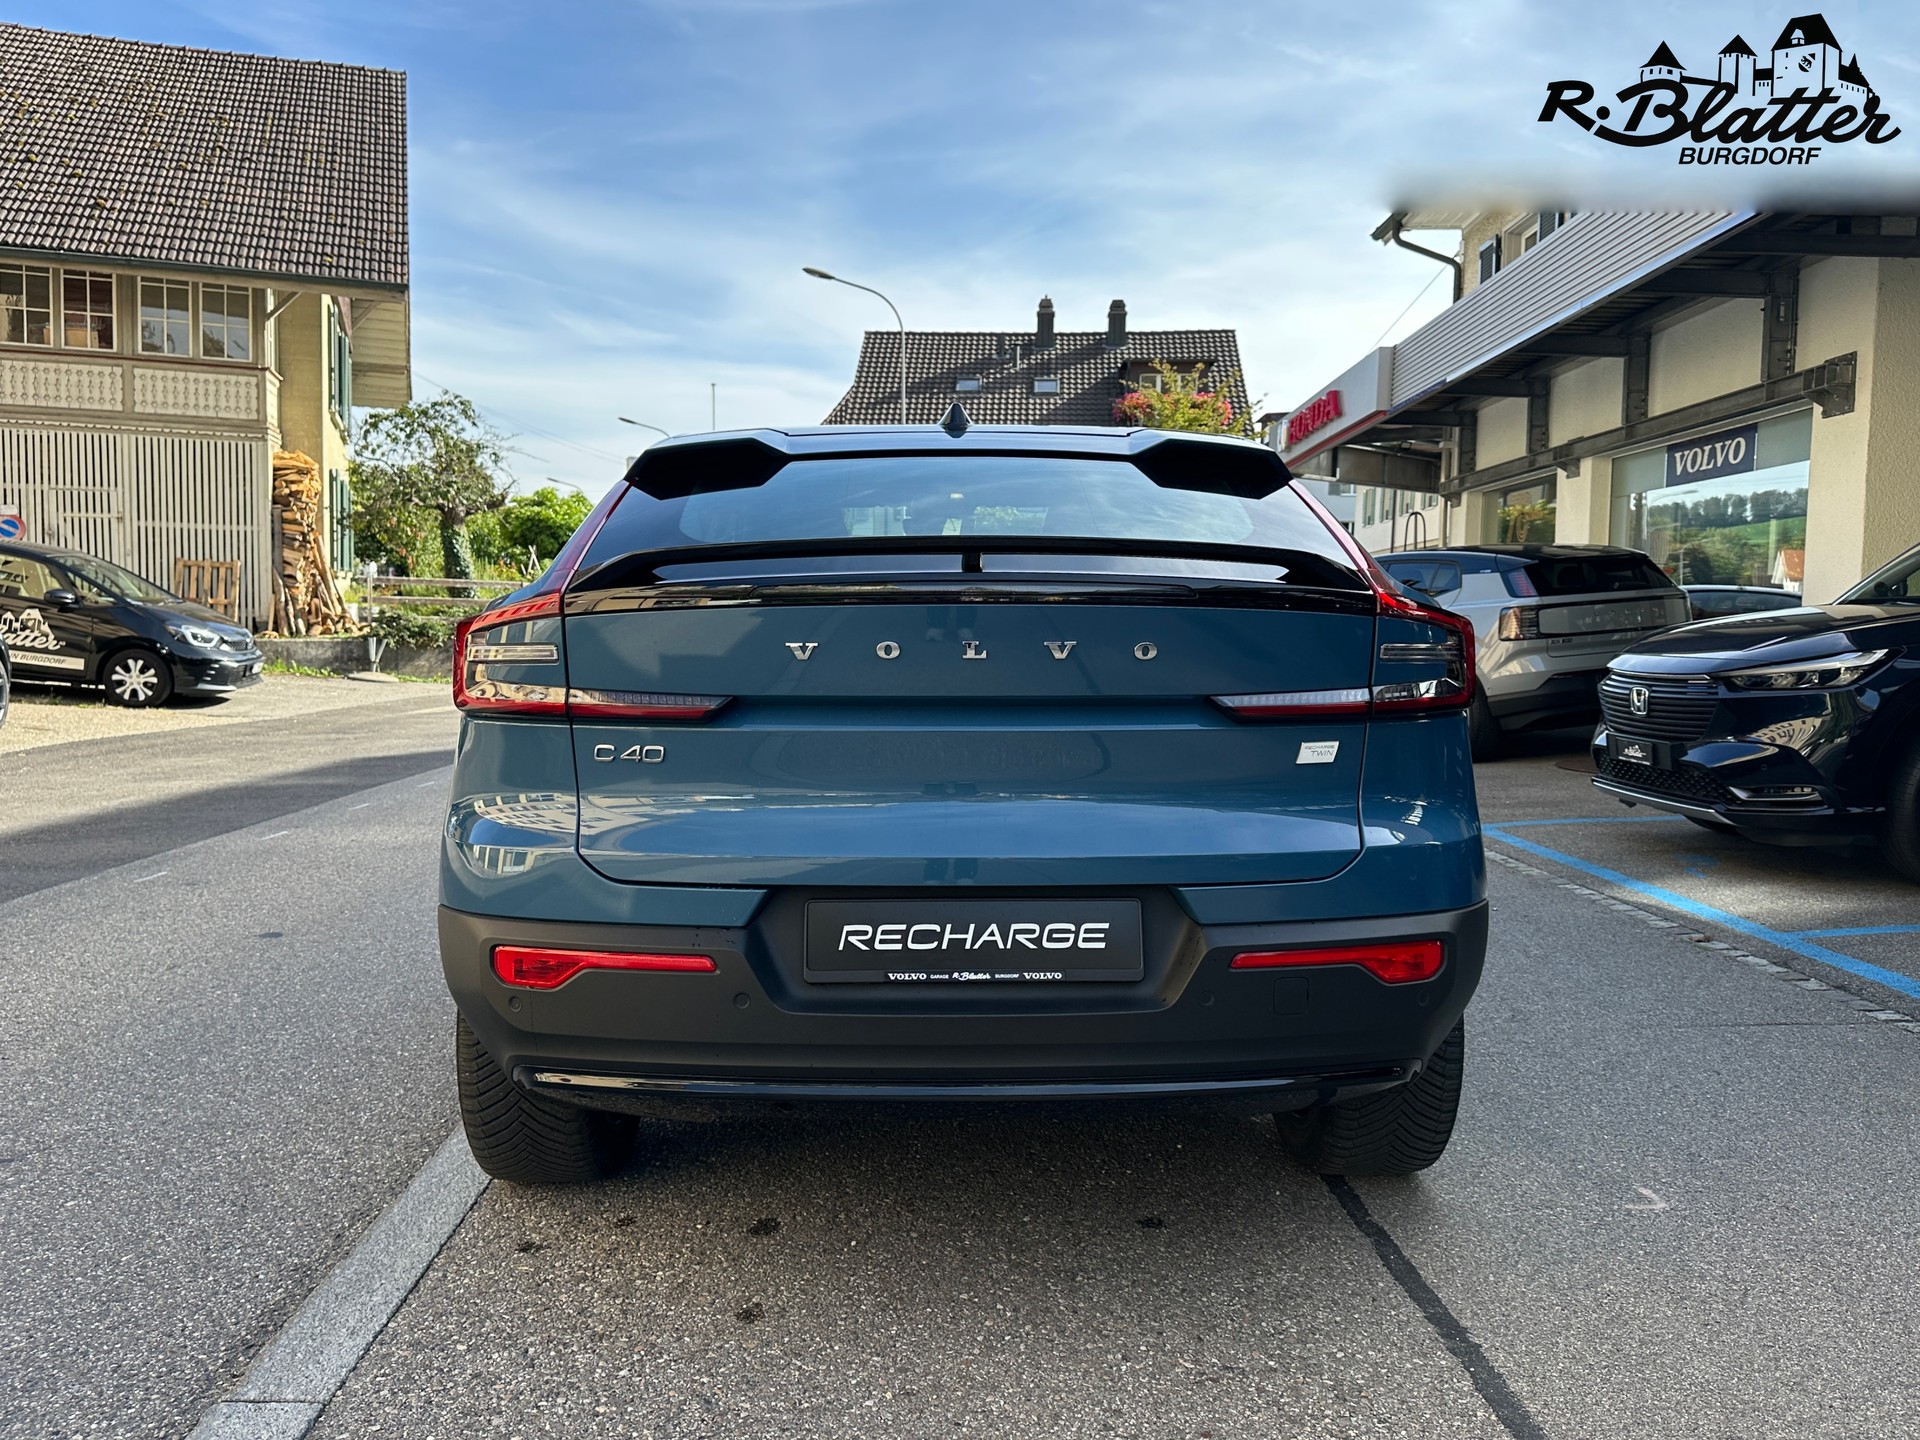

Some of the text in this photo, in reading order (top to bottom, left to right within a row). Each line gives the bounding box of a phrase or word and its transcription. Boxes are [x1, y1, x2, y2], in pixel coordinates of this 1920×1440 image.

[1288, 390, 1341, 445] HONDA
[1674, 437, 1746, 476] VOLVO
[20, 653, 67, 665] BURGDORF
[785, 640, 1158, 661] VOLVO
[1310, 749, 1334, 757] TWIN
[838, 922, 1110, 951] RECHARGE
[887, 972, 927, 981] VOLVO
[1022, 972, 1063, 980] VOLVO
